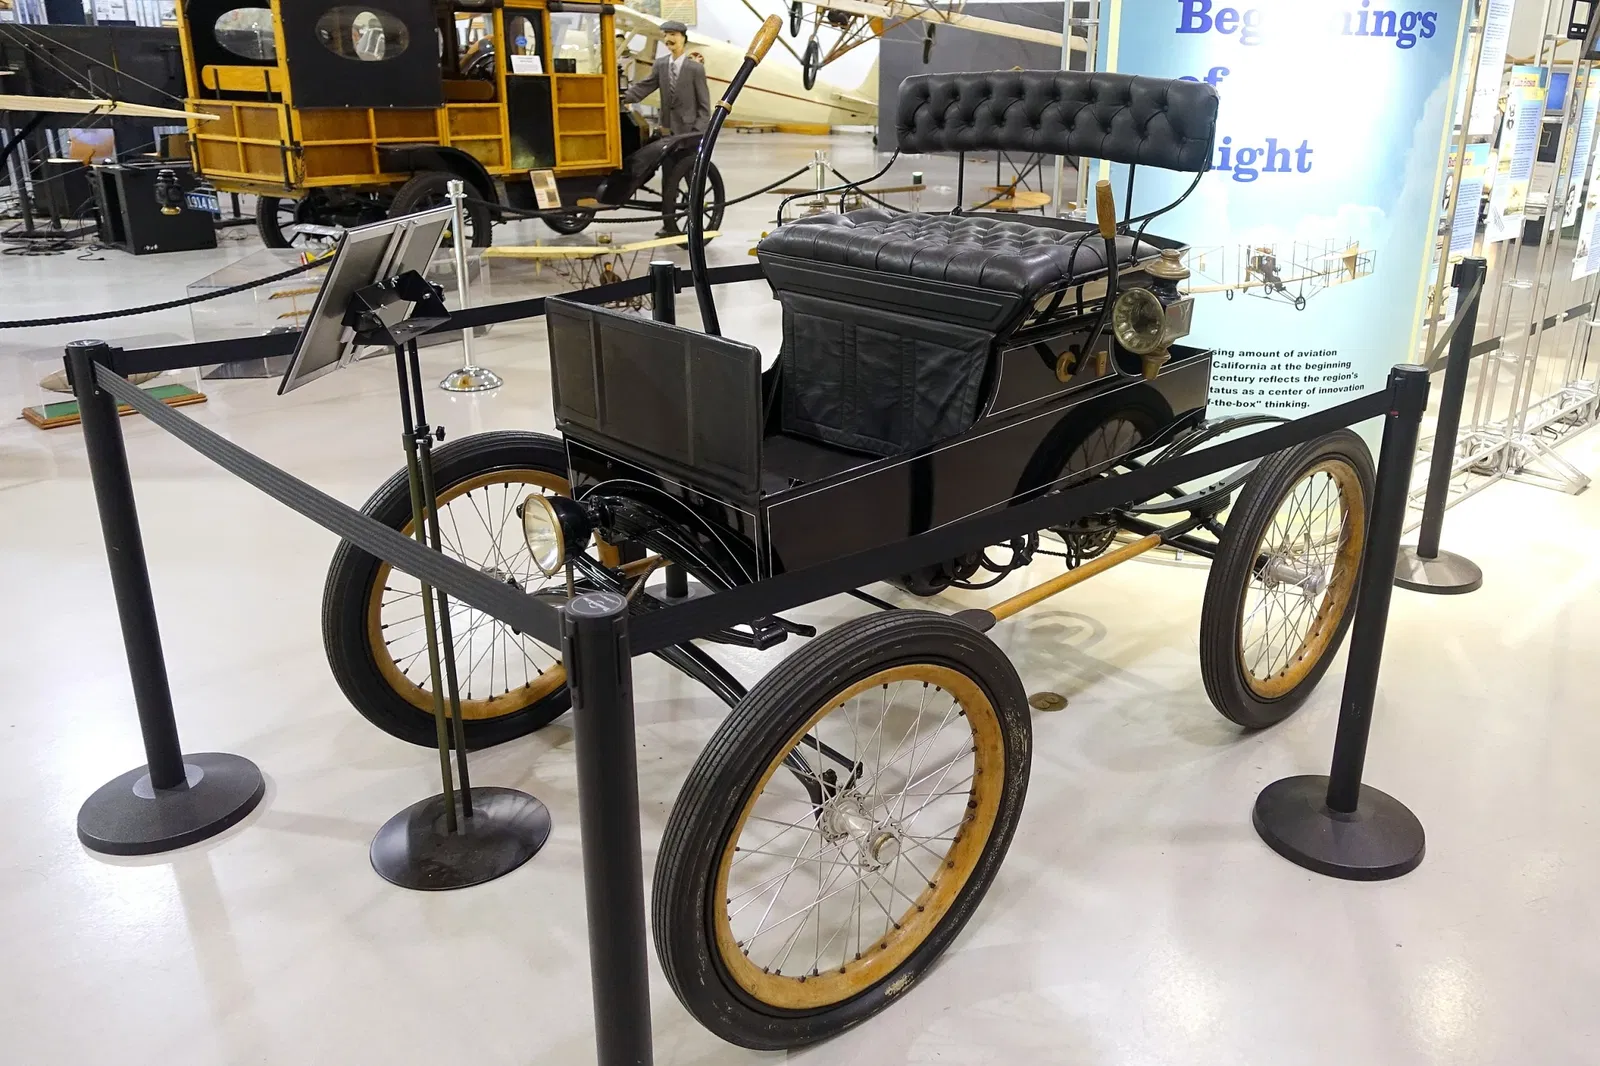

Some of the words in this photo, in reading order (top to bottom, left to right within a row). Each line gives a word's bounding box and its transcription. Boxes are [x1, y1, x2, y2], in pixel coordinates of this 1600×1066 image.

[1210, 136, 1313, 182] ight
[1209, 347, 1235, 358] sing
[1238, 350, 1280, 358] amount
[1283, 349, 1295, 358] of
[1297, 348, 1338, 358] aviation
[1212, 360, 1267, 370] California
[1305, 360, 1352, 371] beginning
[1212, 375, 1255, 384] century
[1258, 375, 1300, 383] reflects
[1303, 374, 1320, 382] the
[1322, 371, 1359, 382] region's
[1209, 386, 1238, 395] tatus
[1268, 388, 1303, 396] center
[1305, 387, 1316, 395] of
[1318, 383, 1365, 394] innovation
[1207, 398, 1262, 408] f-the-box"
[1265, 400, 1310, 409] thinking.
